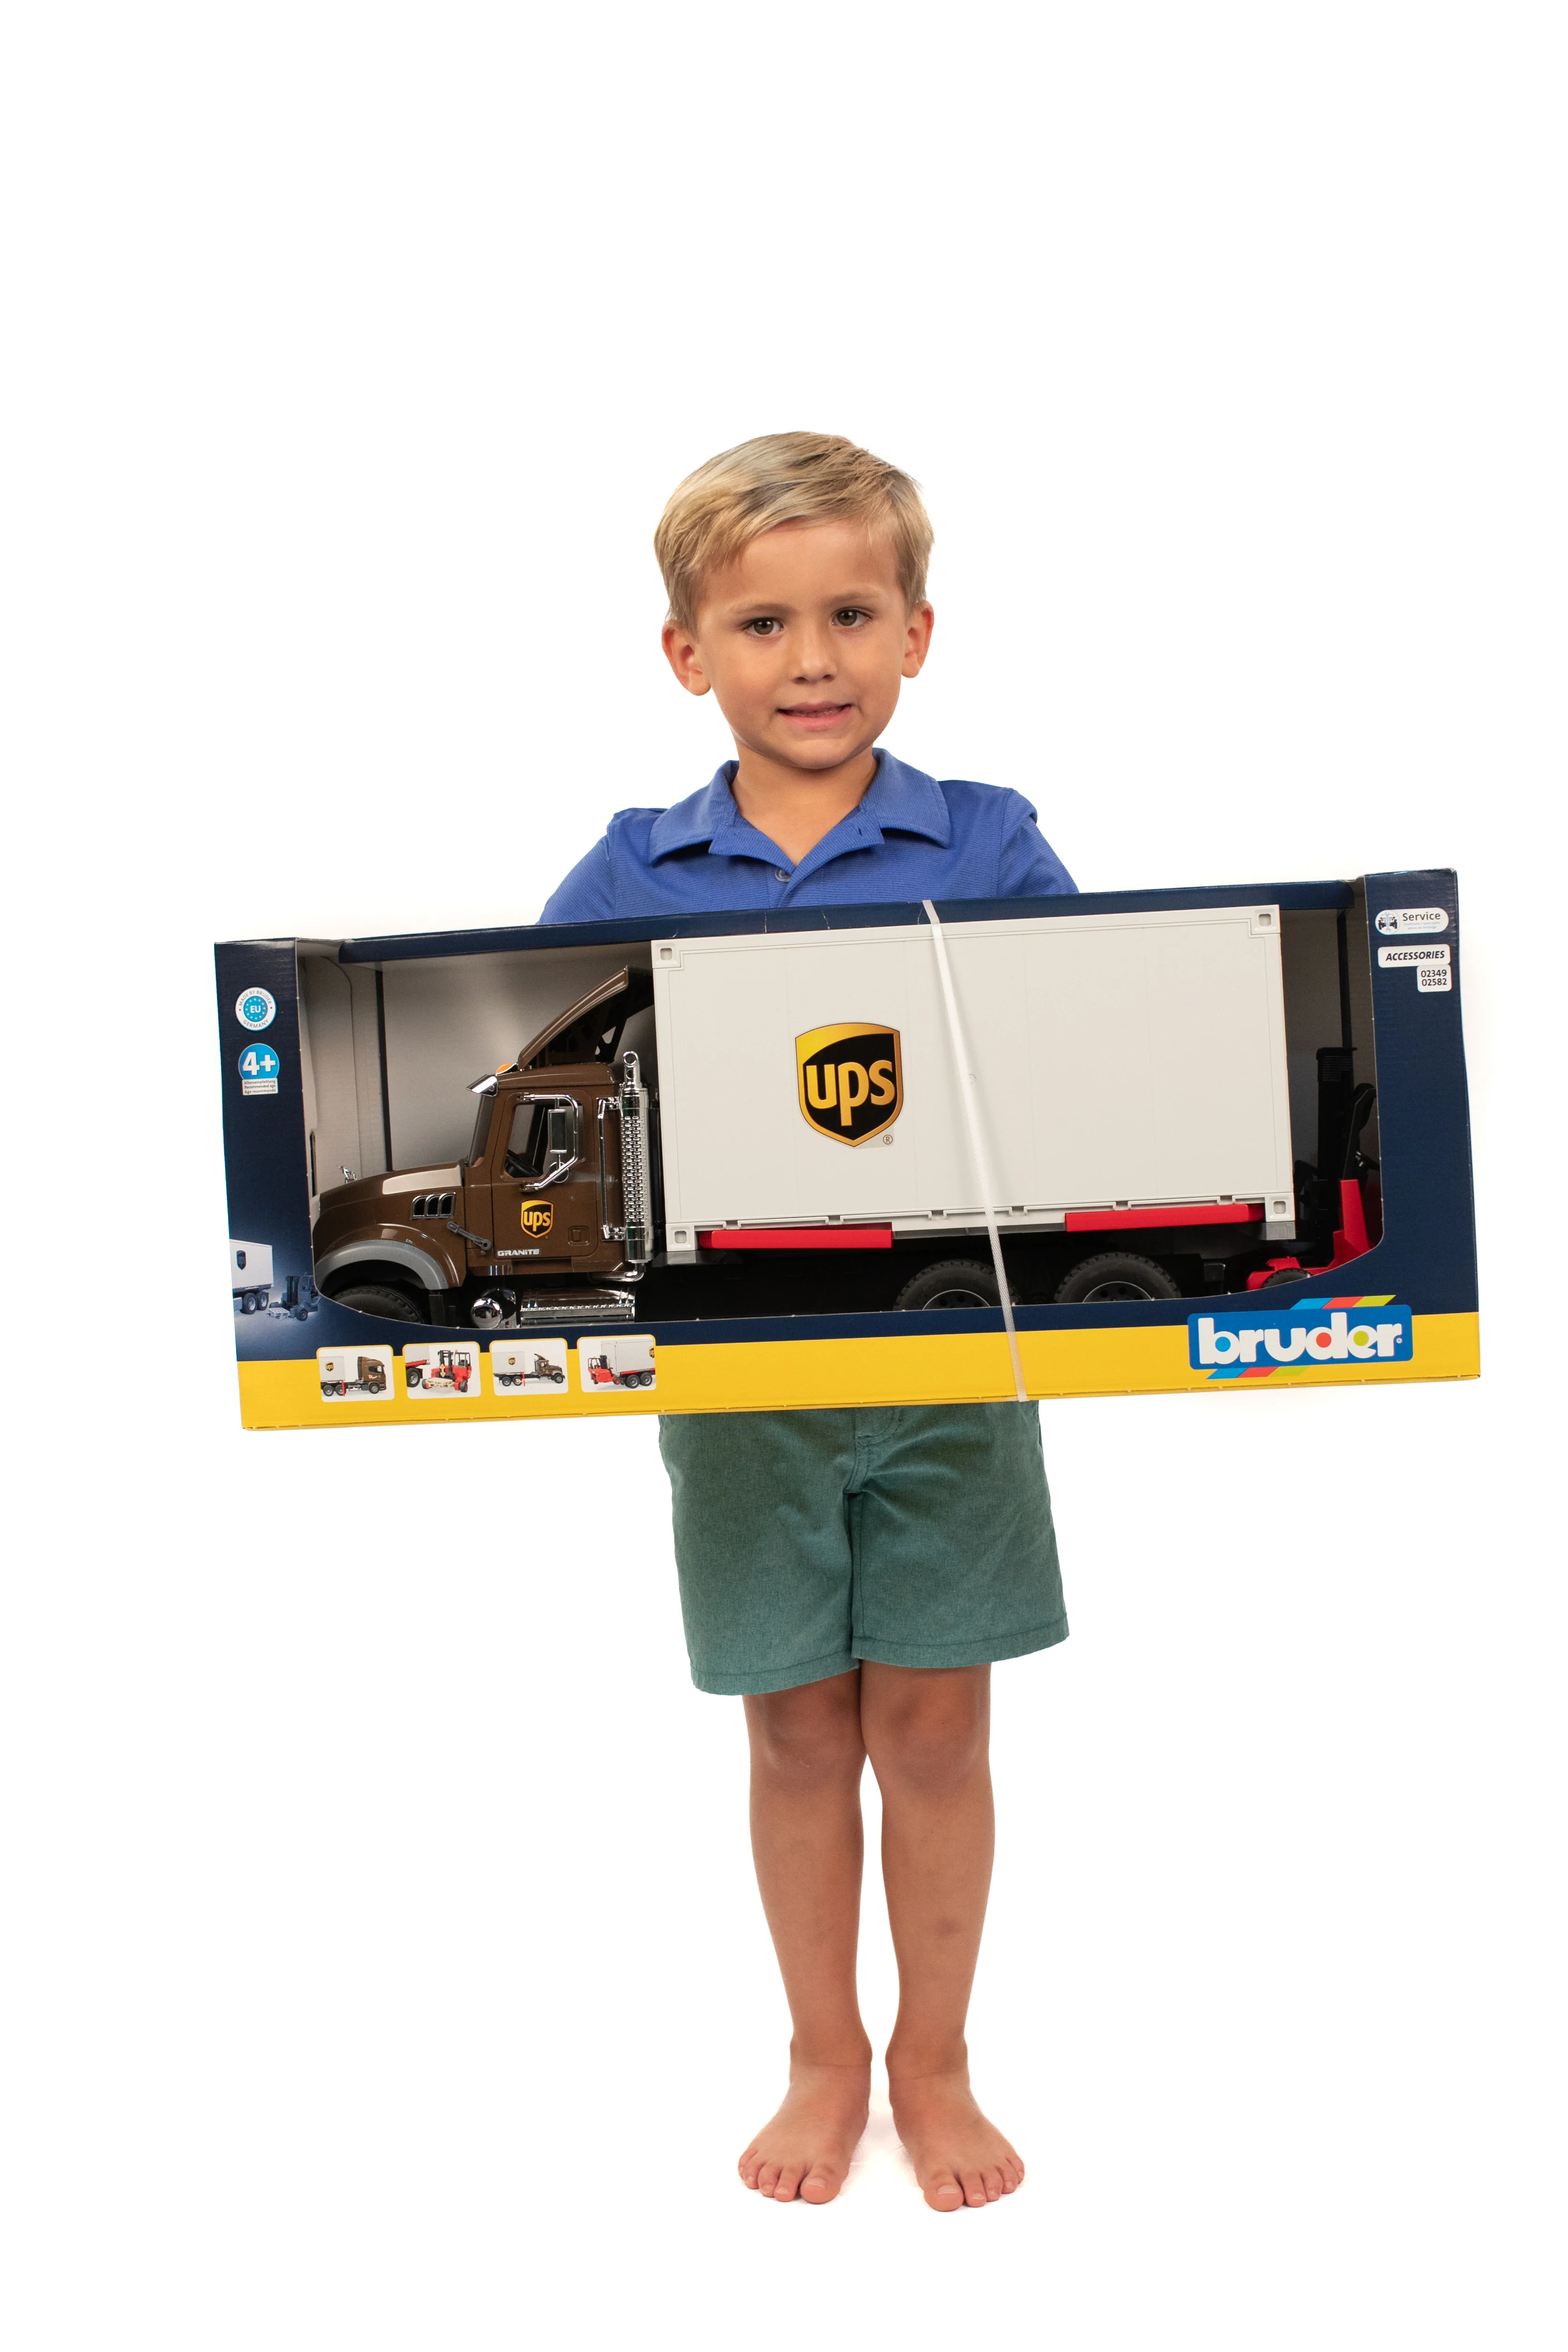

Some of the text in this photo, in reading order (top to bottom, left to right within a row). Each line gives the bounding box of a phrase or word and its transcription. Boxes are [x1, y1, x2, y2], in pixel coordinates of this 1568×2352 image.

[1402, 911, 1441, 921] Service
[1386, 951, 1445, 961] ACCESSORIES
[239, 993, 249, 1006] MADE
[257, 990, 272, 1004] BRUDER
[243, 1019, 269, 1028] GERMANY
[243, 1052, 276, 1076] 4+
[806, 1060, 895, 1126] ups
[524, 1211, 551, 1232] ups
[1198, 1312, 1402, 1365] bruder
